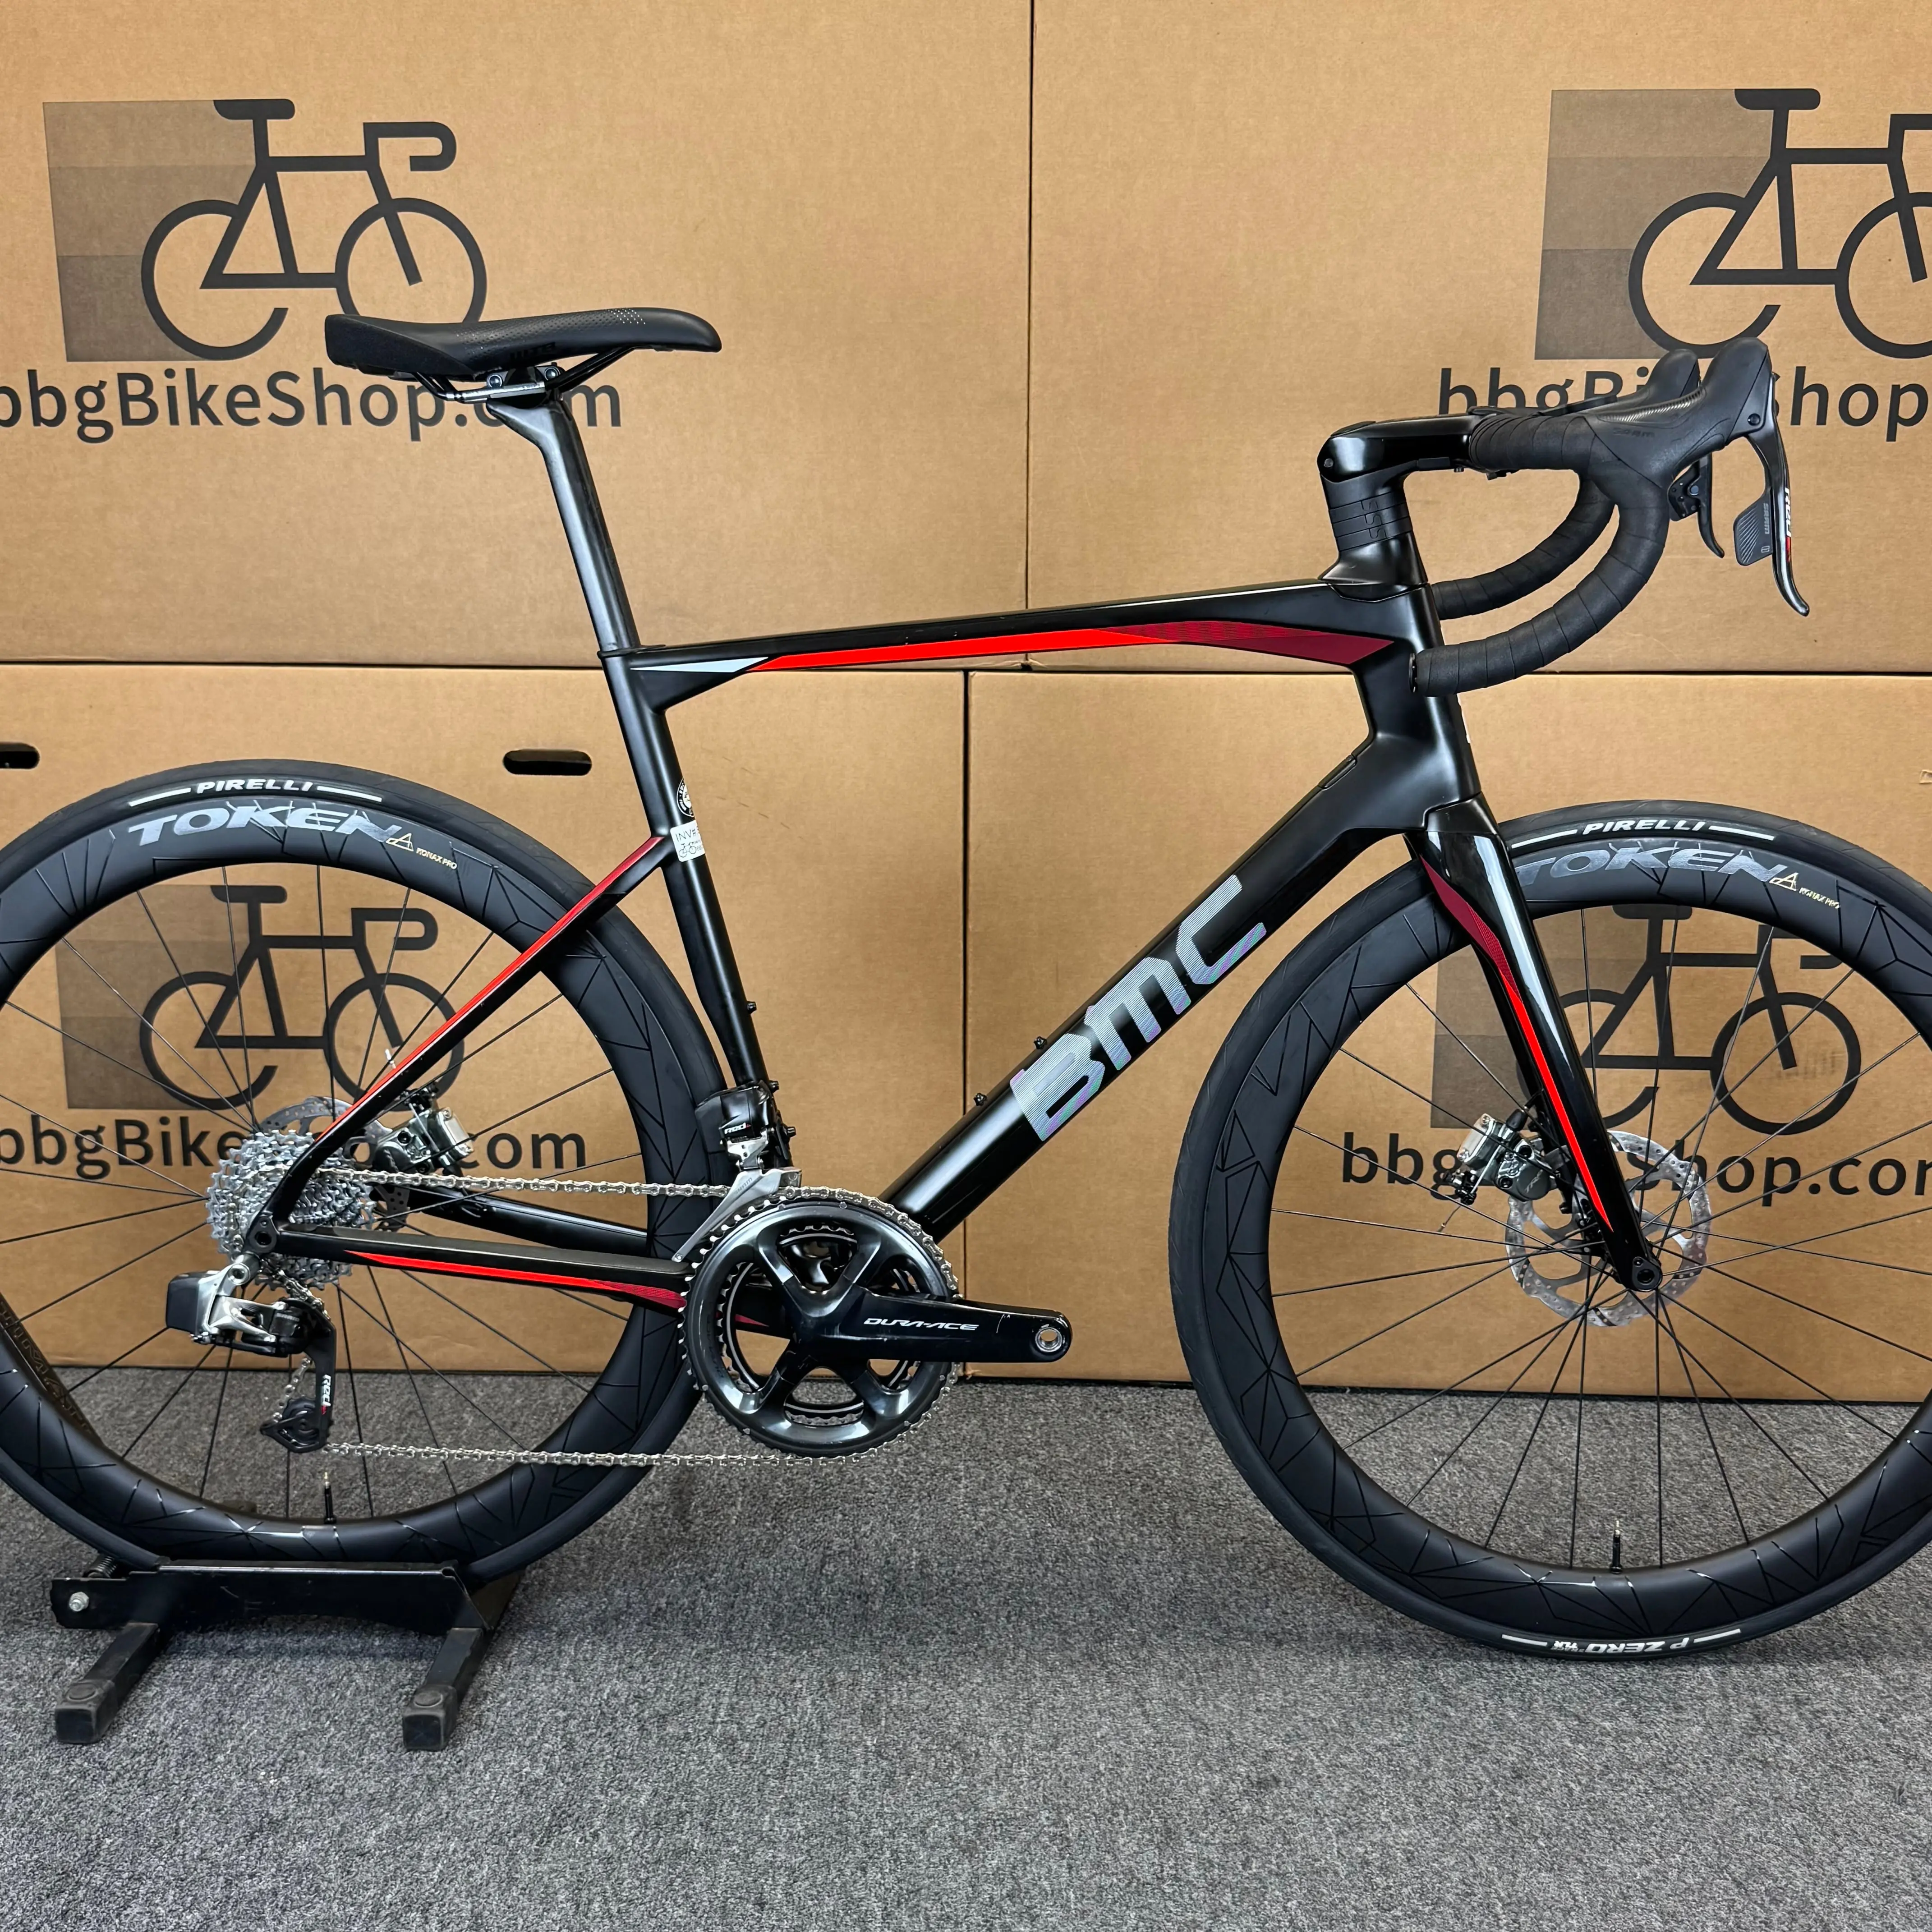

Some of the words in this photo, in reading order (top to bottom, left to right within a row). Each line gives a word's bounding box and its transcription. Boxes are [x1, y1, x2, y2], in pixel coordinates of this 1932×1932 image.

[196, 779, 313, 794] PIRELLI
[128, 805, 402, 846] TOKEN
[1583, 819, 1707, 835] PIRELLI
[1516, 846, 1788, 887] TOKEN
[1009, 874, 1267, 1142] BMC
[864, 1317, 980, 1331] DURA-ACE
[1585, 1641, 1665, 1654] ZERO
[1670, 1637, 1689, 1650] P
